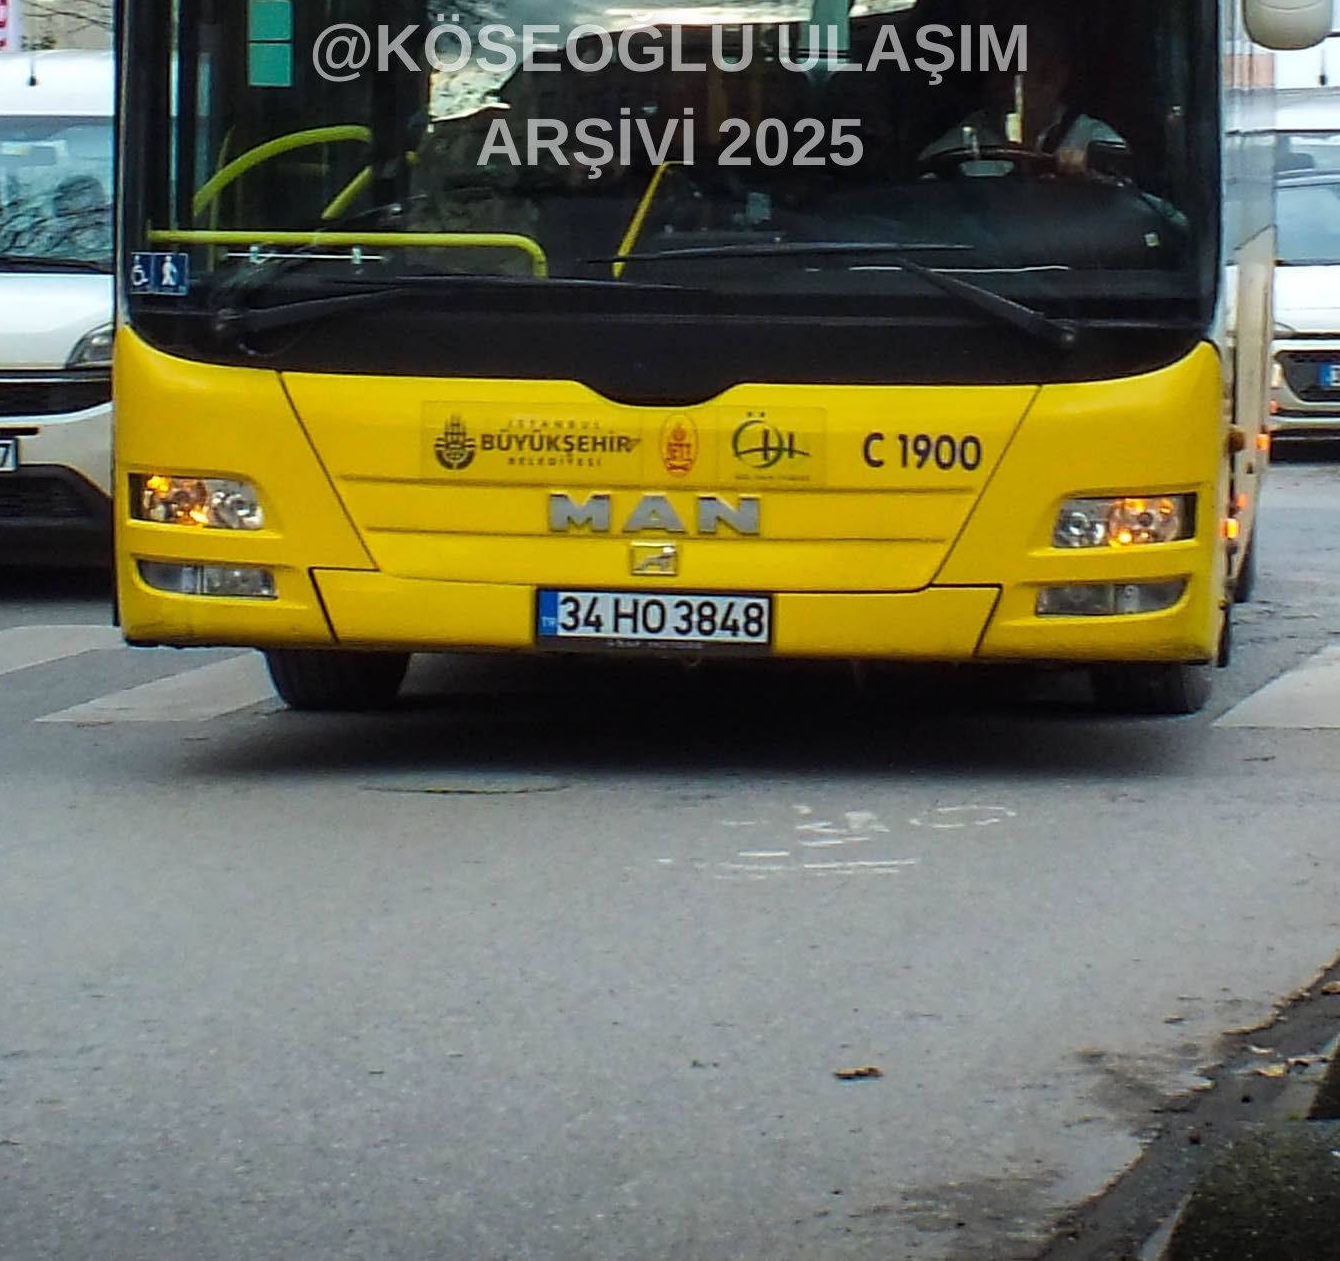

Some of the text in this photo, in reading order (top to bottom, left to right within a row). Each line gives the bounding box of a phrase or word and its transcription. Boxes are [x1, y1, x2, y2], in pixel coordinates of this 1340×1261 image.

[480, 429, 632, 456] BÜYÜKŞEHİR
[863, 432, 982, 471] C 1900
[549, 493, 760, 535] MAN
[560, 595, 765, 637] 34 HO 3848
